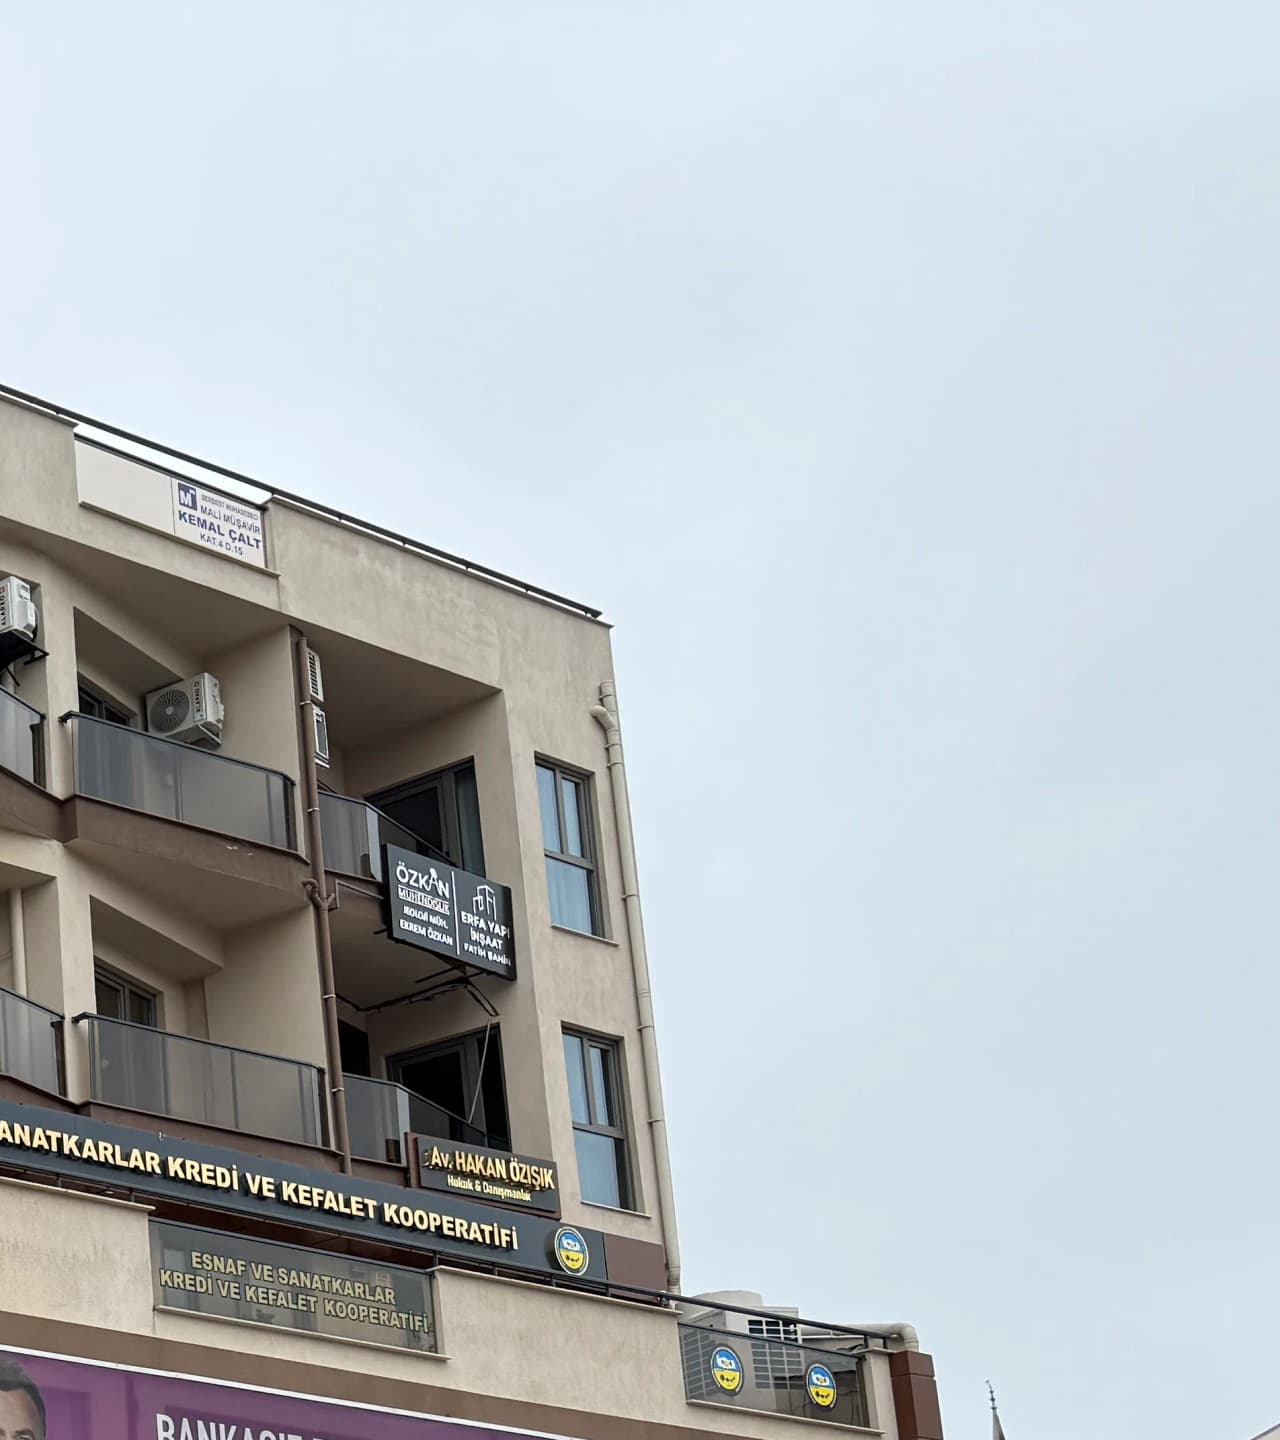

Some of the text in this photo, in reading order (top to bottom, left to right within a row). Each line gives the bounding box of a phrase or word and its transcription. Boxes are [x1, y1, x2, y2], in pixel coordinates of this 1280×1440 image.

[178, 511, 261, 549] KEMAL ÇALT
[395, 860, 450, 899] ÖZKAN
[461, 910, 487, 931] ERFA
[470, 928, 503, 950] İNŞAAT
[431, 1146, 556, 1191] Av. HAKAN ÖZIŞIK
[166, 1156, 240, 1192] KREDİ
[245, 1171, 277, 1199] VE
[281, 1180, 379, 1221] KEFALET
[382, 1201, 520, 1251] KOOPERATİFİ
[190, 1250, 397, 1306] ESNAF VE SANATKARLAR
[159, 1268, 430, 1336] KREDİ VE KEFALET KOOPERATİFİ
